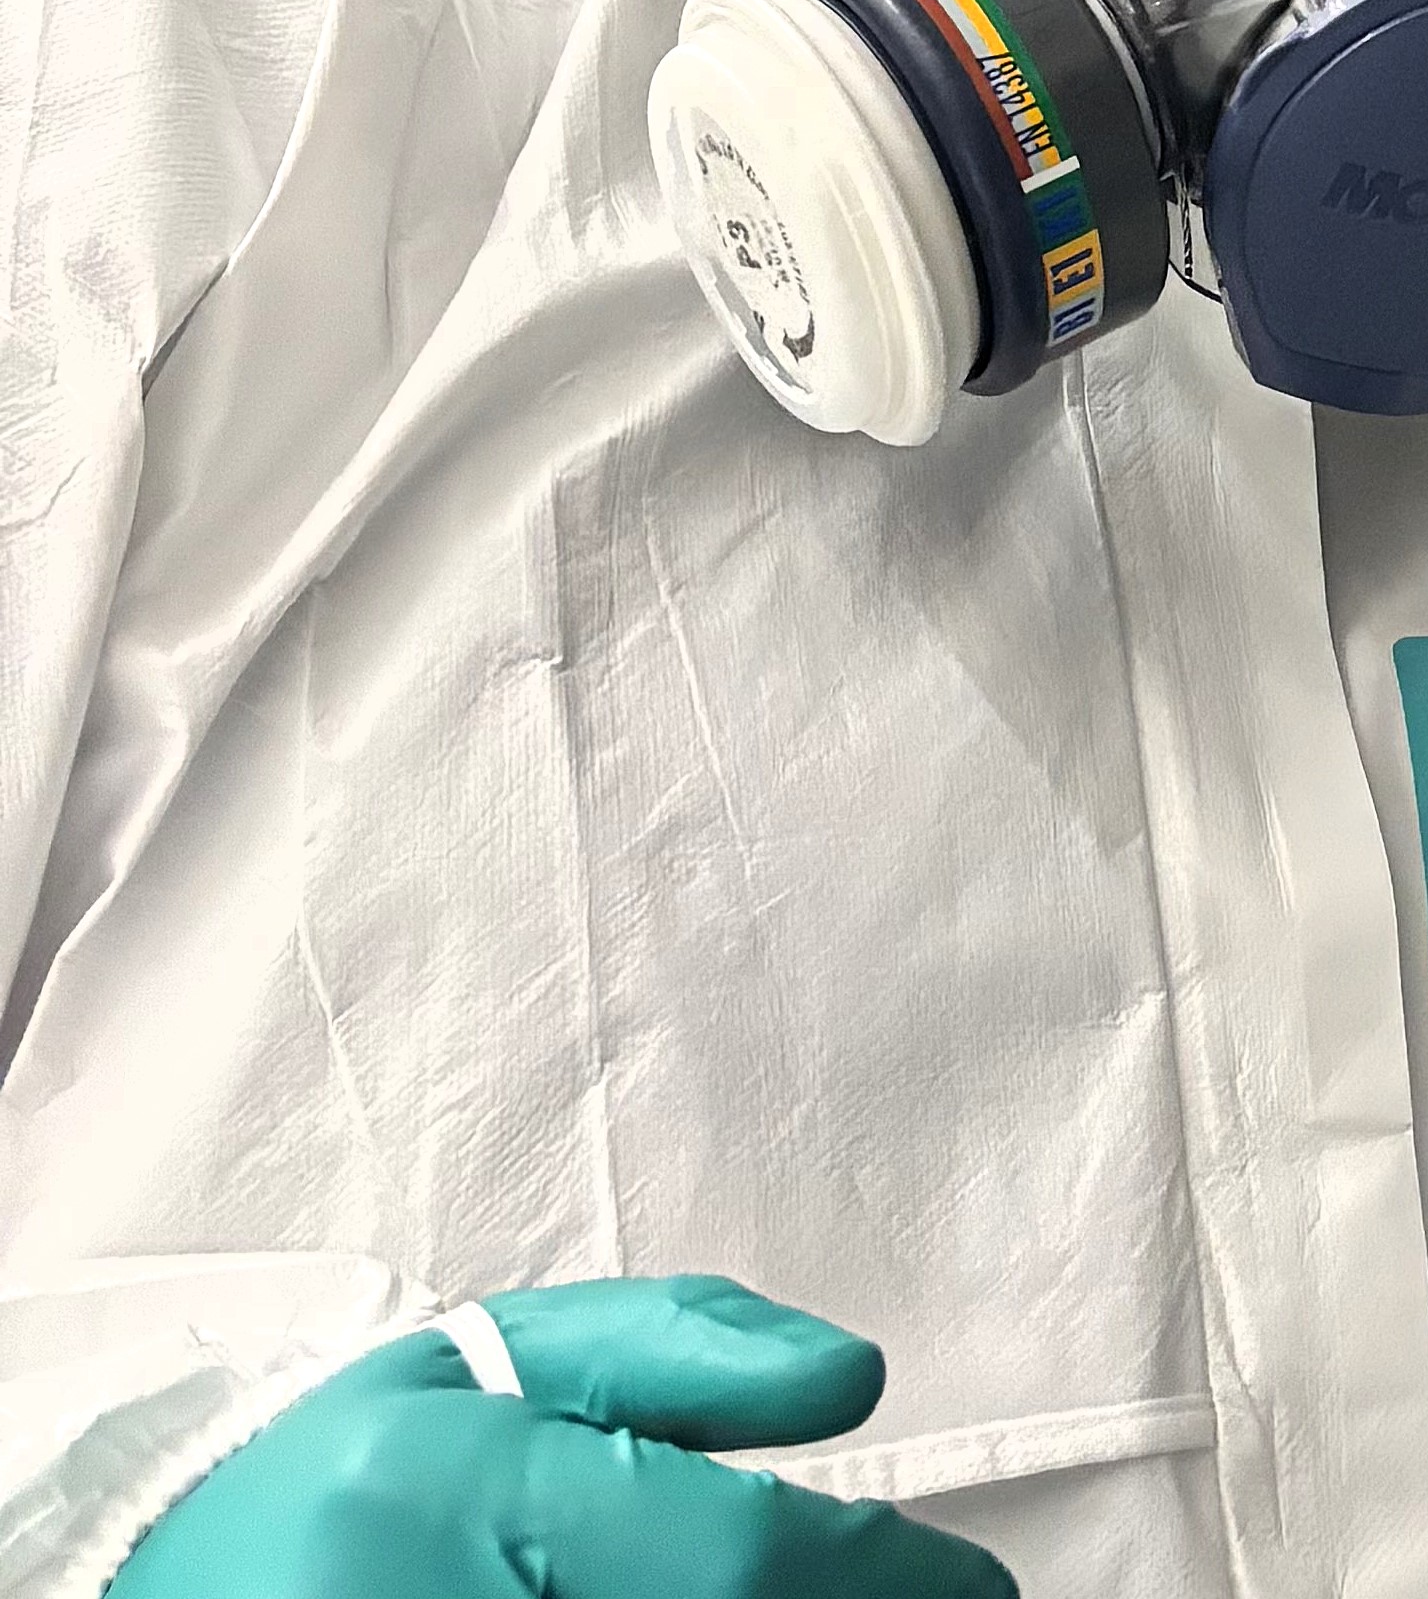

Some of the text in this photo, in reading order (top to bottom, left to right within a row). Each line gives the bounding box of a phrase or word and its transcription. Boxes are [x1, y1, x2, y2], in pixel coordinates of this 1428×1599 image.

[976, 51, 1055, 159] EN 14387
[1050, 247, 1096, 296] E1
[1052, 298, 1096, 340] B1
